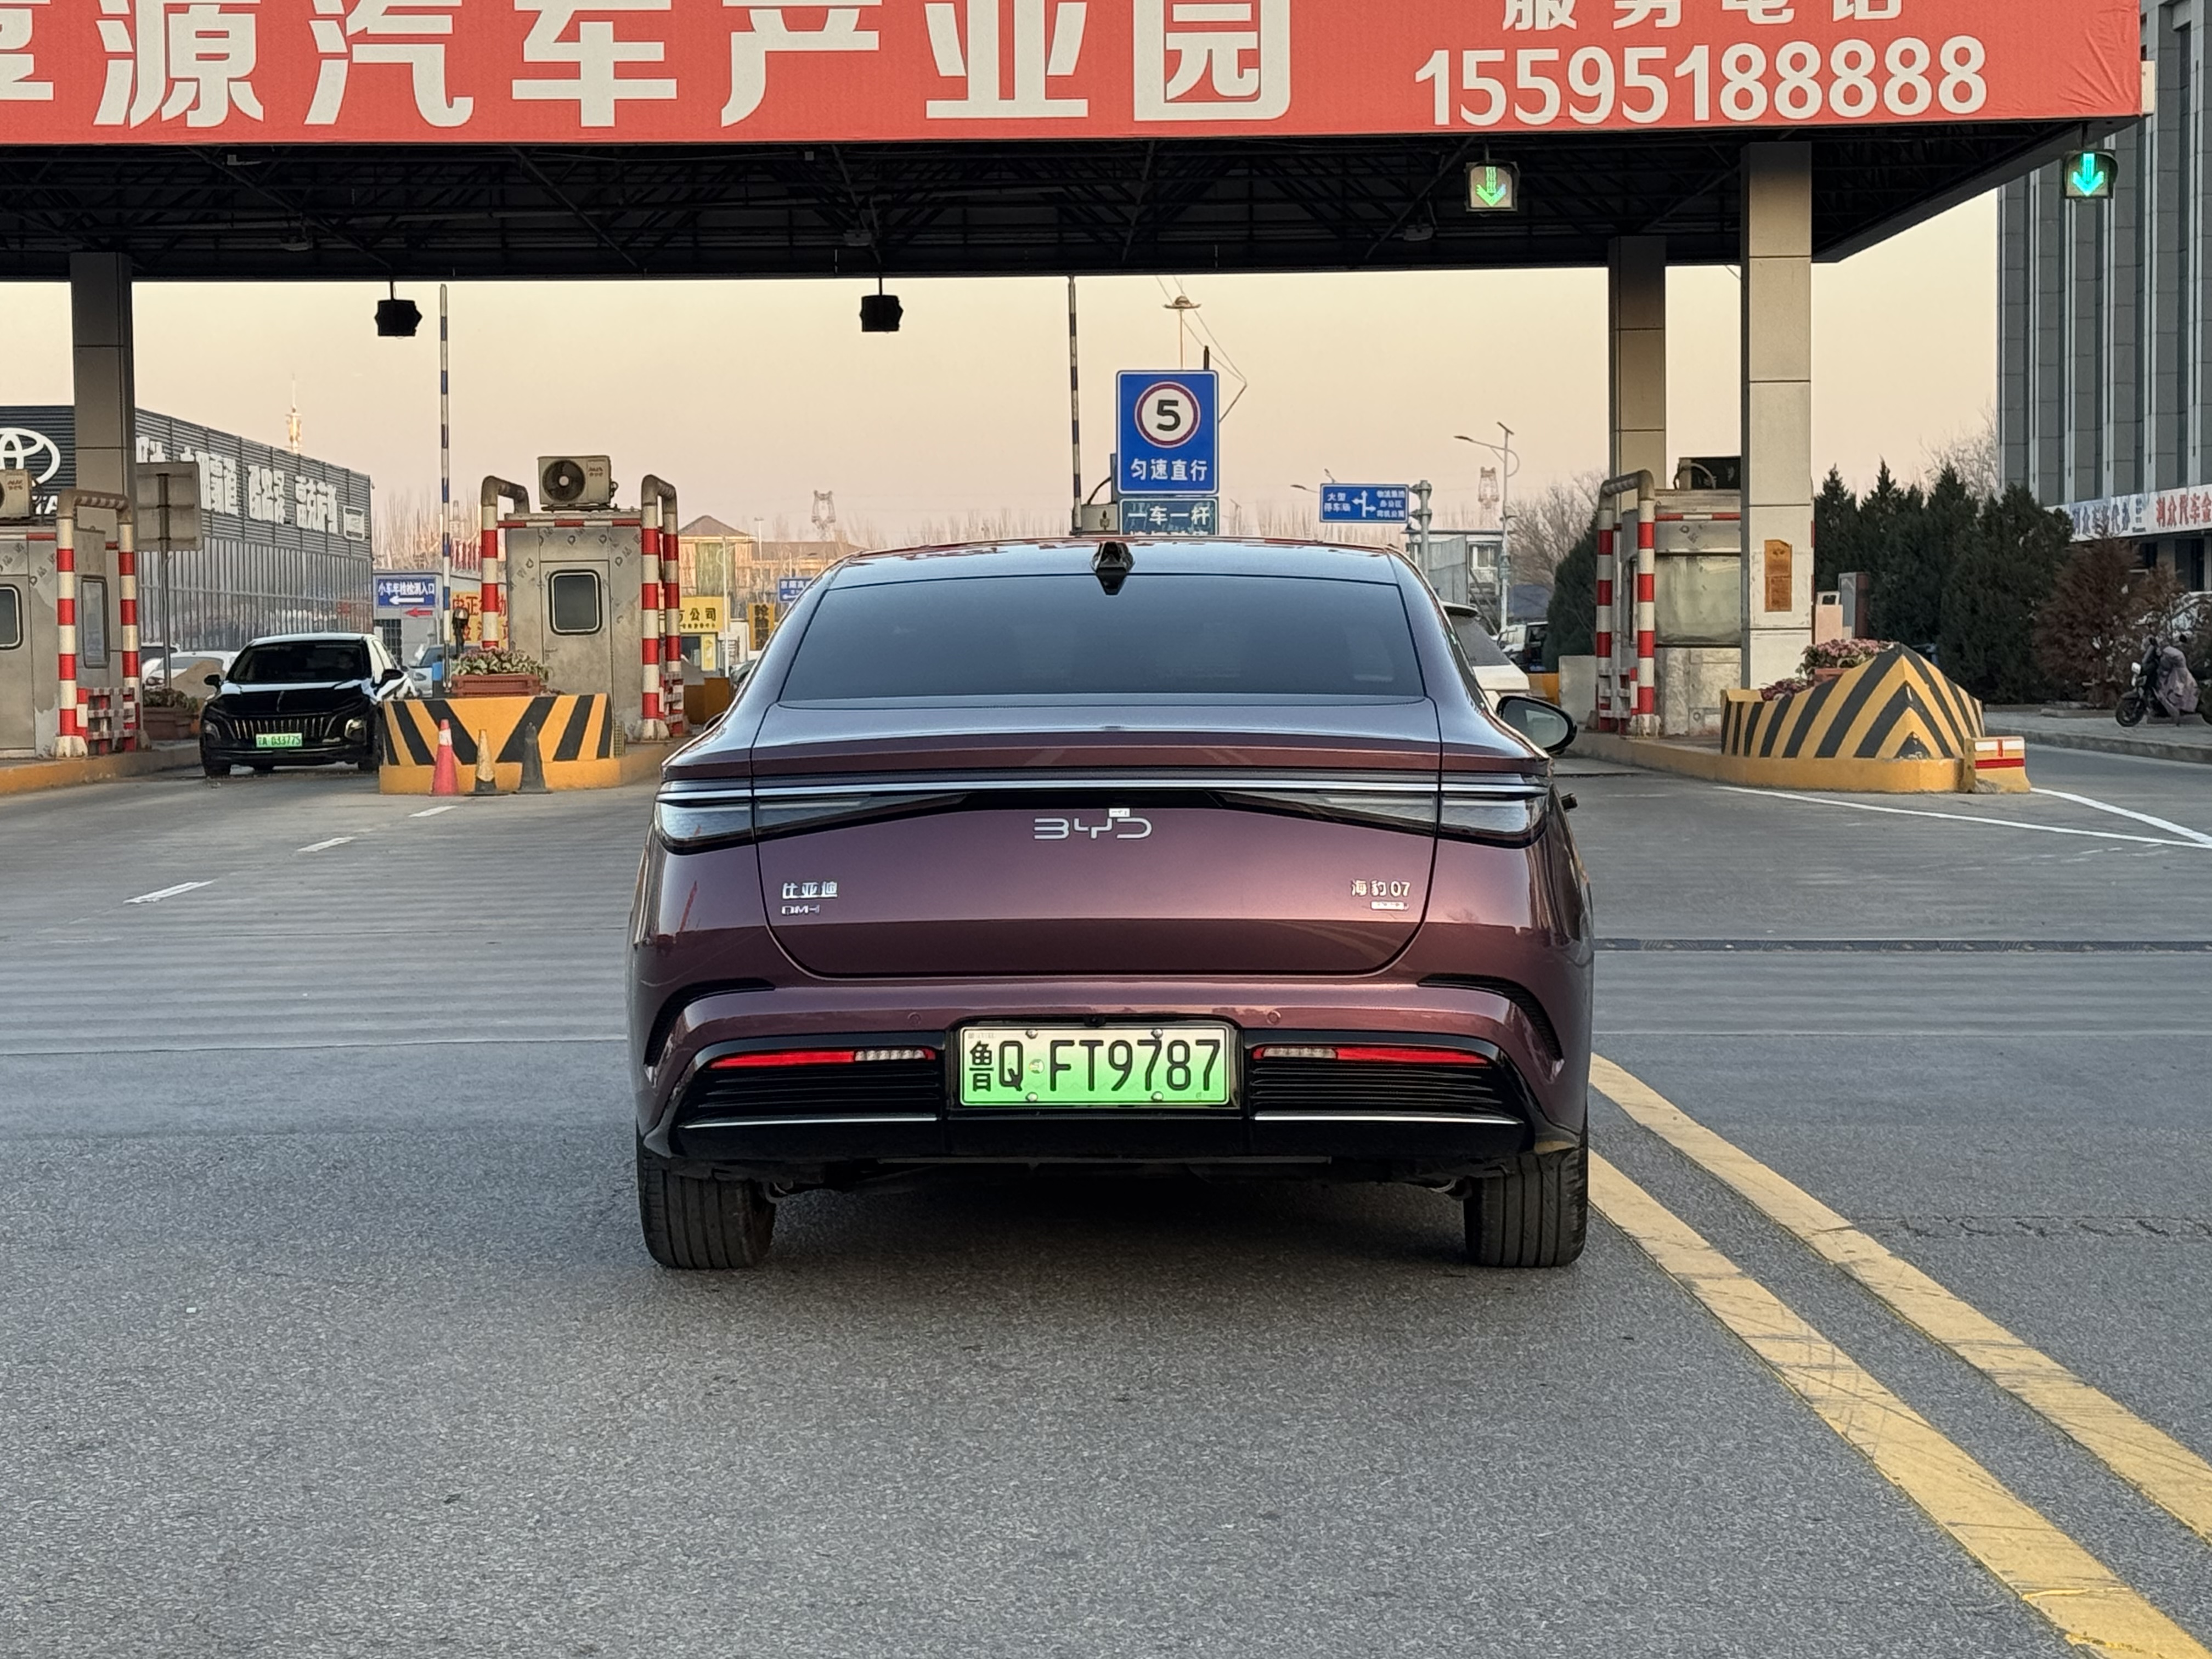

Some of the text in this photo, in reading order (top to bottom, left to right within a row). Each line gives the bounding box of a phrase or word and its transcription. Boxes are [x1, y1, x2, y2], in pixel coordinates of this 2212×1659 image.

[1415, 36, 1987, 126] 15595188888
[1156, 399, 1181, 431] 5
[1130, 458, 1207, 481] 匀速直行
[1127, 506, 1211, 526] 一车一杆
[1034, 818, 1152, 839] BYD
